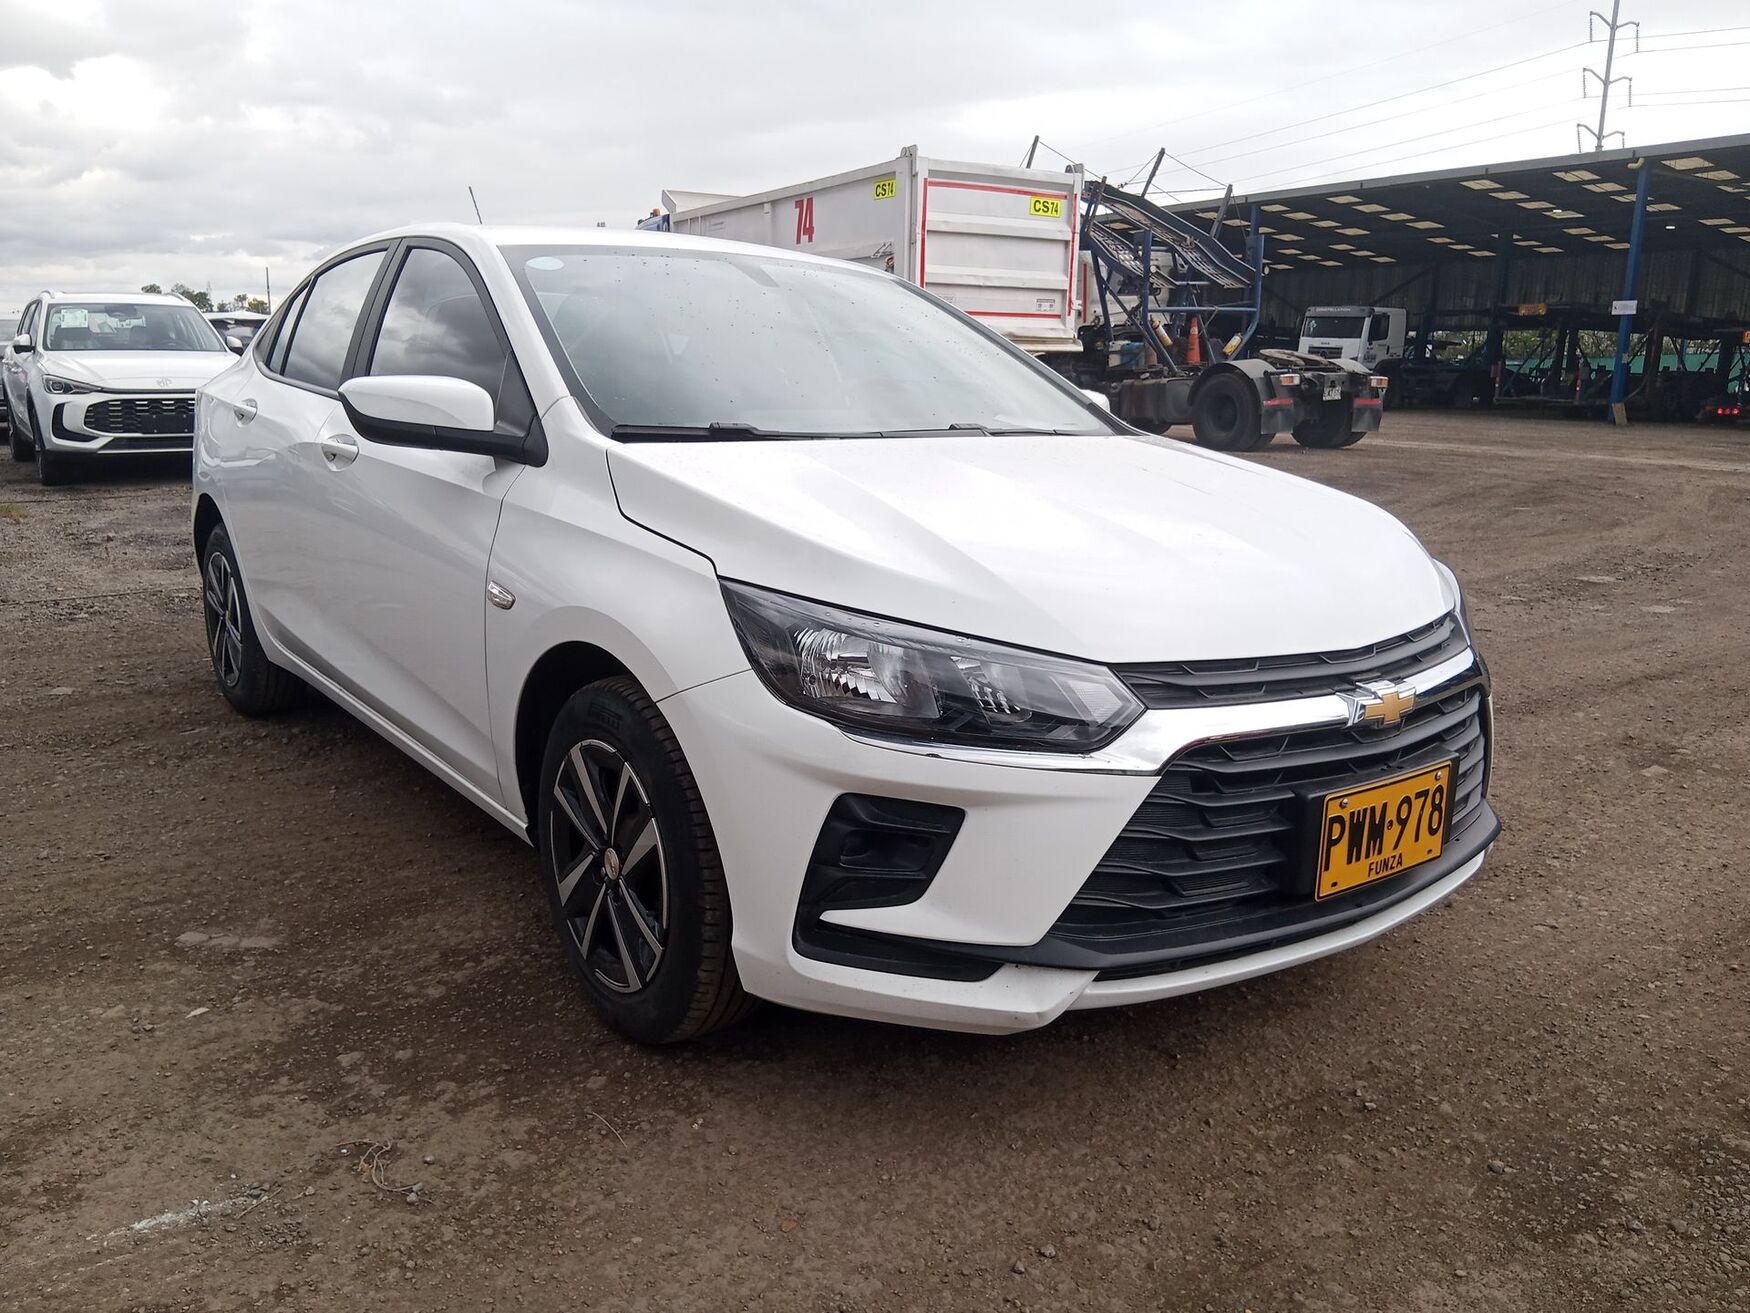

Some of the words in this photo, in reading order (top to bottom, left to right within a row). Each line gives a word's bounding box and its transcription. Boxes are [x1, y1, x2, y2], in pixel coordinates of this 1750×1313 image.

[875, 182, 894, 198] CS74
[1033, 199, 1059, 216] CS74
[794, 197, 815, 245] 74
[1367, 852, 1403, 878] FUNZA
